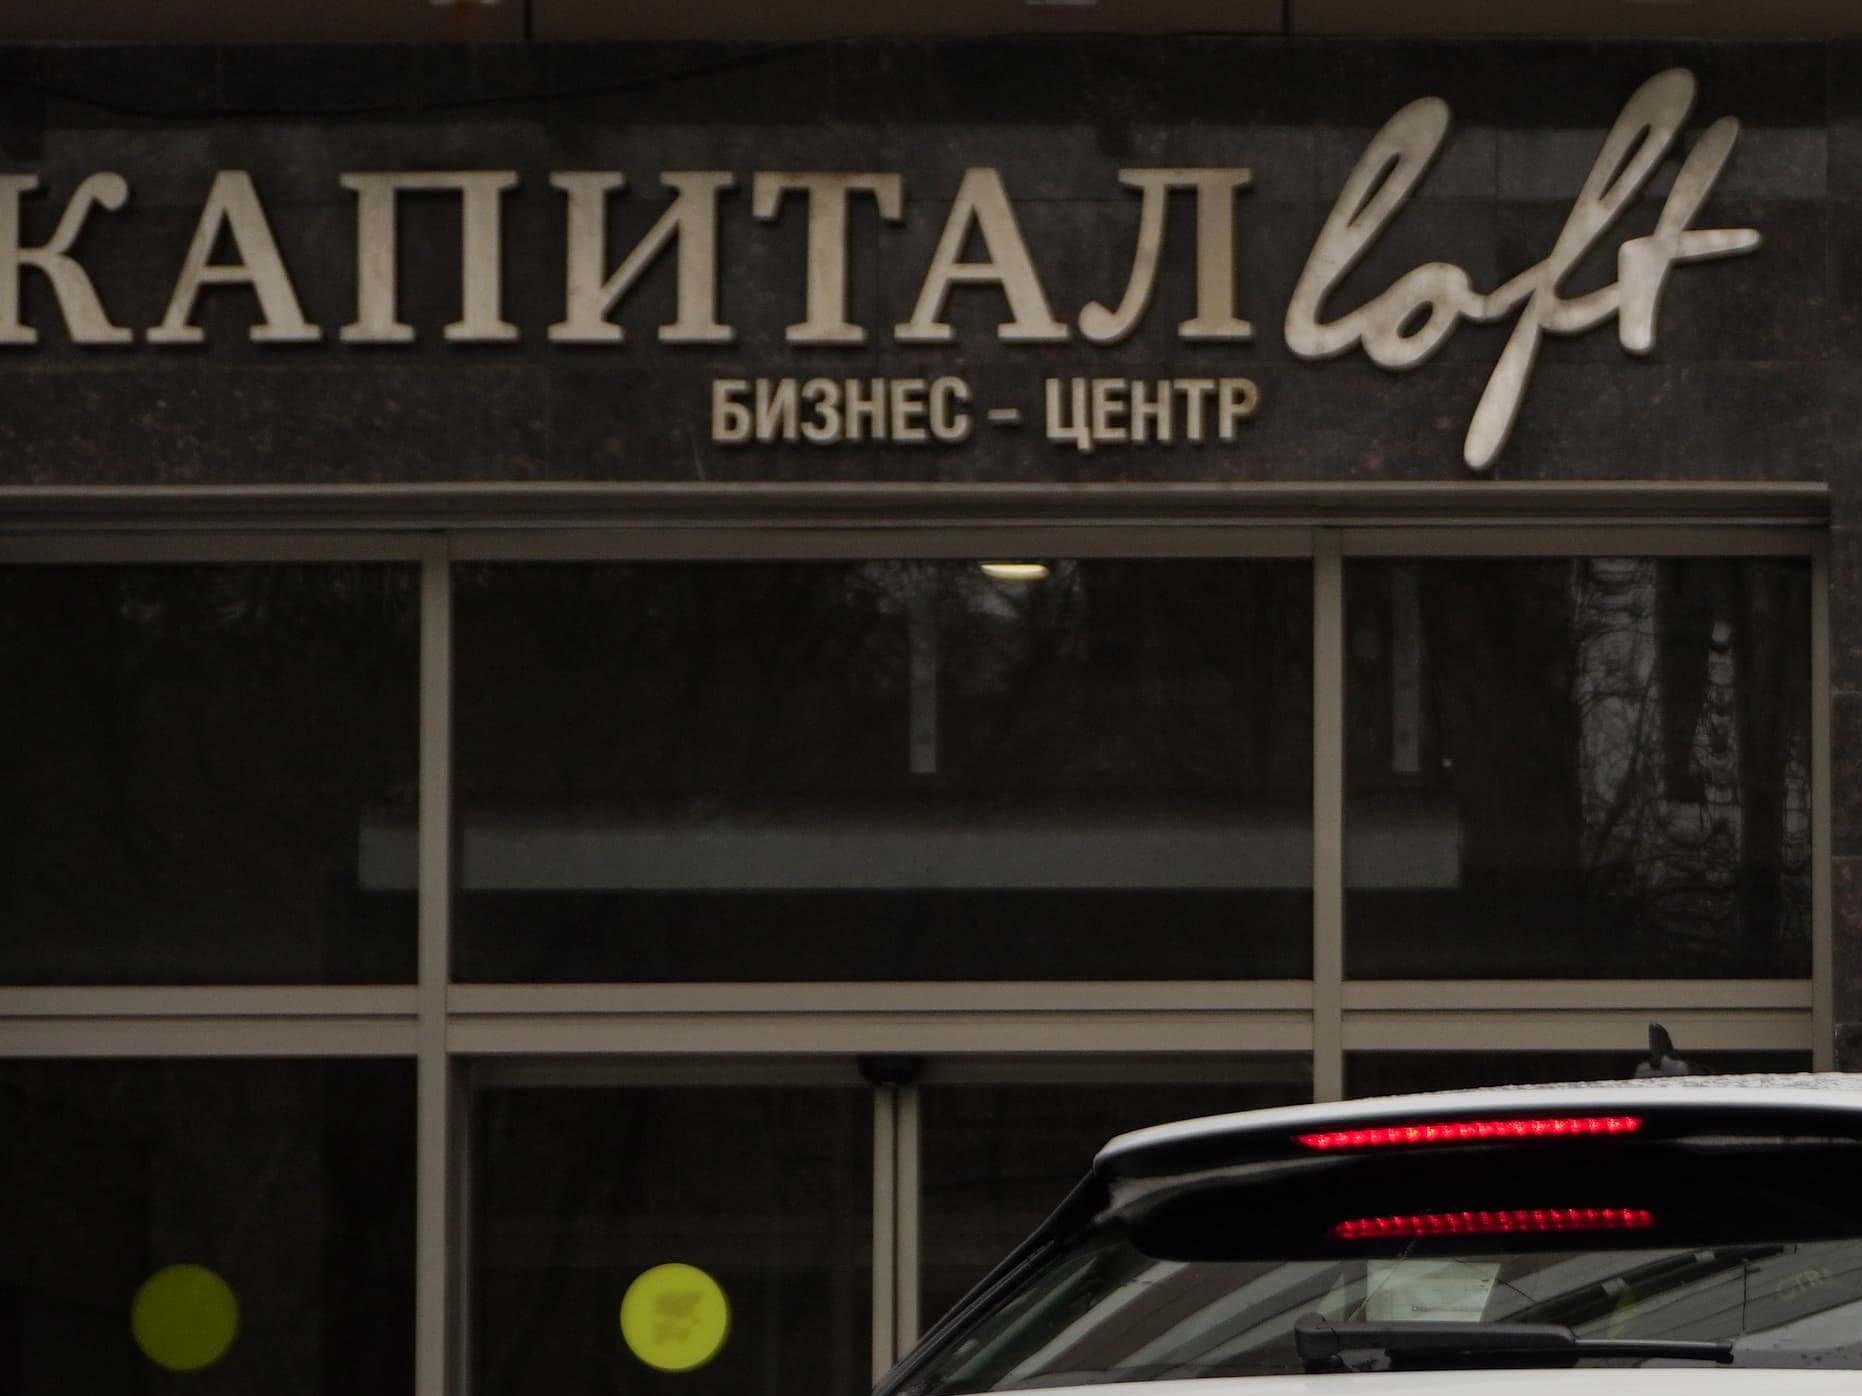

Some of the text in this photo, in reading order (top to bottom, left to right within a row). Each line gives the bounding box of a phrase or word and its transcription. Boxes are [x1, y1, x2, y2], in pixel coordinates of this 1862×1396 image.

[0, 167, 1252, 344] КАПИТАЛ
[1285, 67, 1762, 472] loft
[711, 376, 972, 443] БИЗНЕС
[1045, 377, 1262, 453] ЦЕНТР
